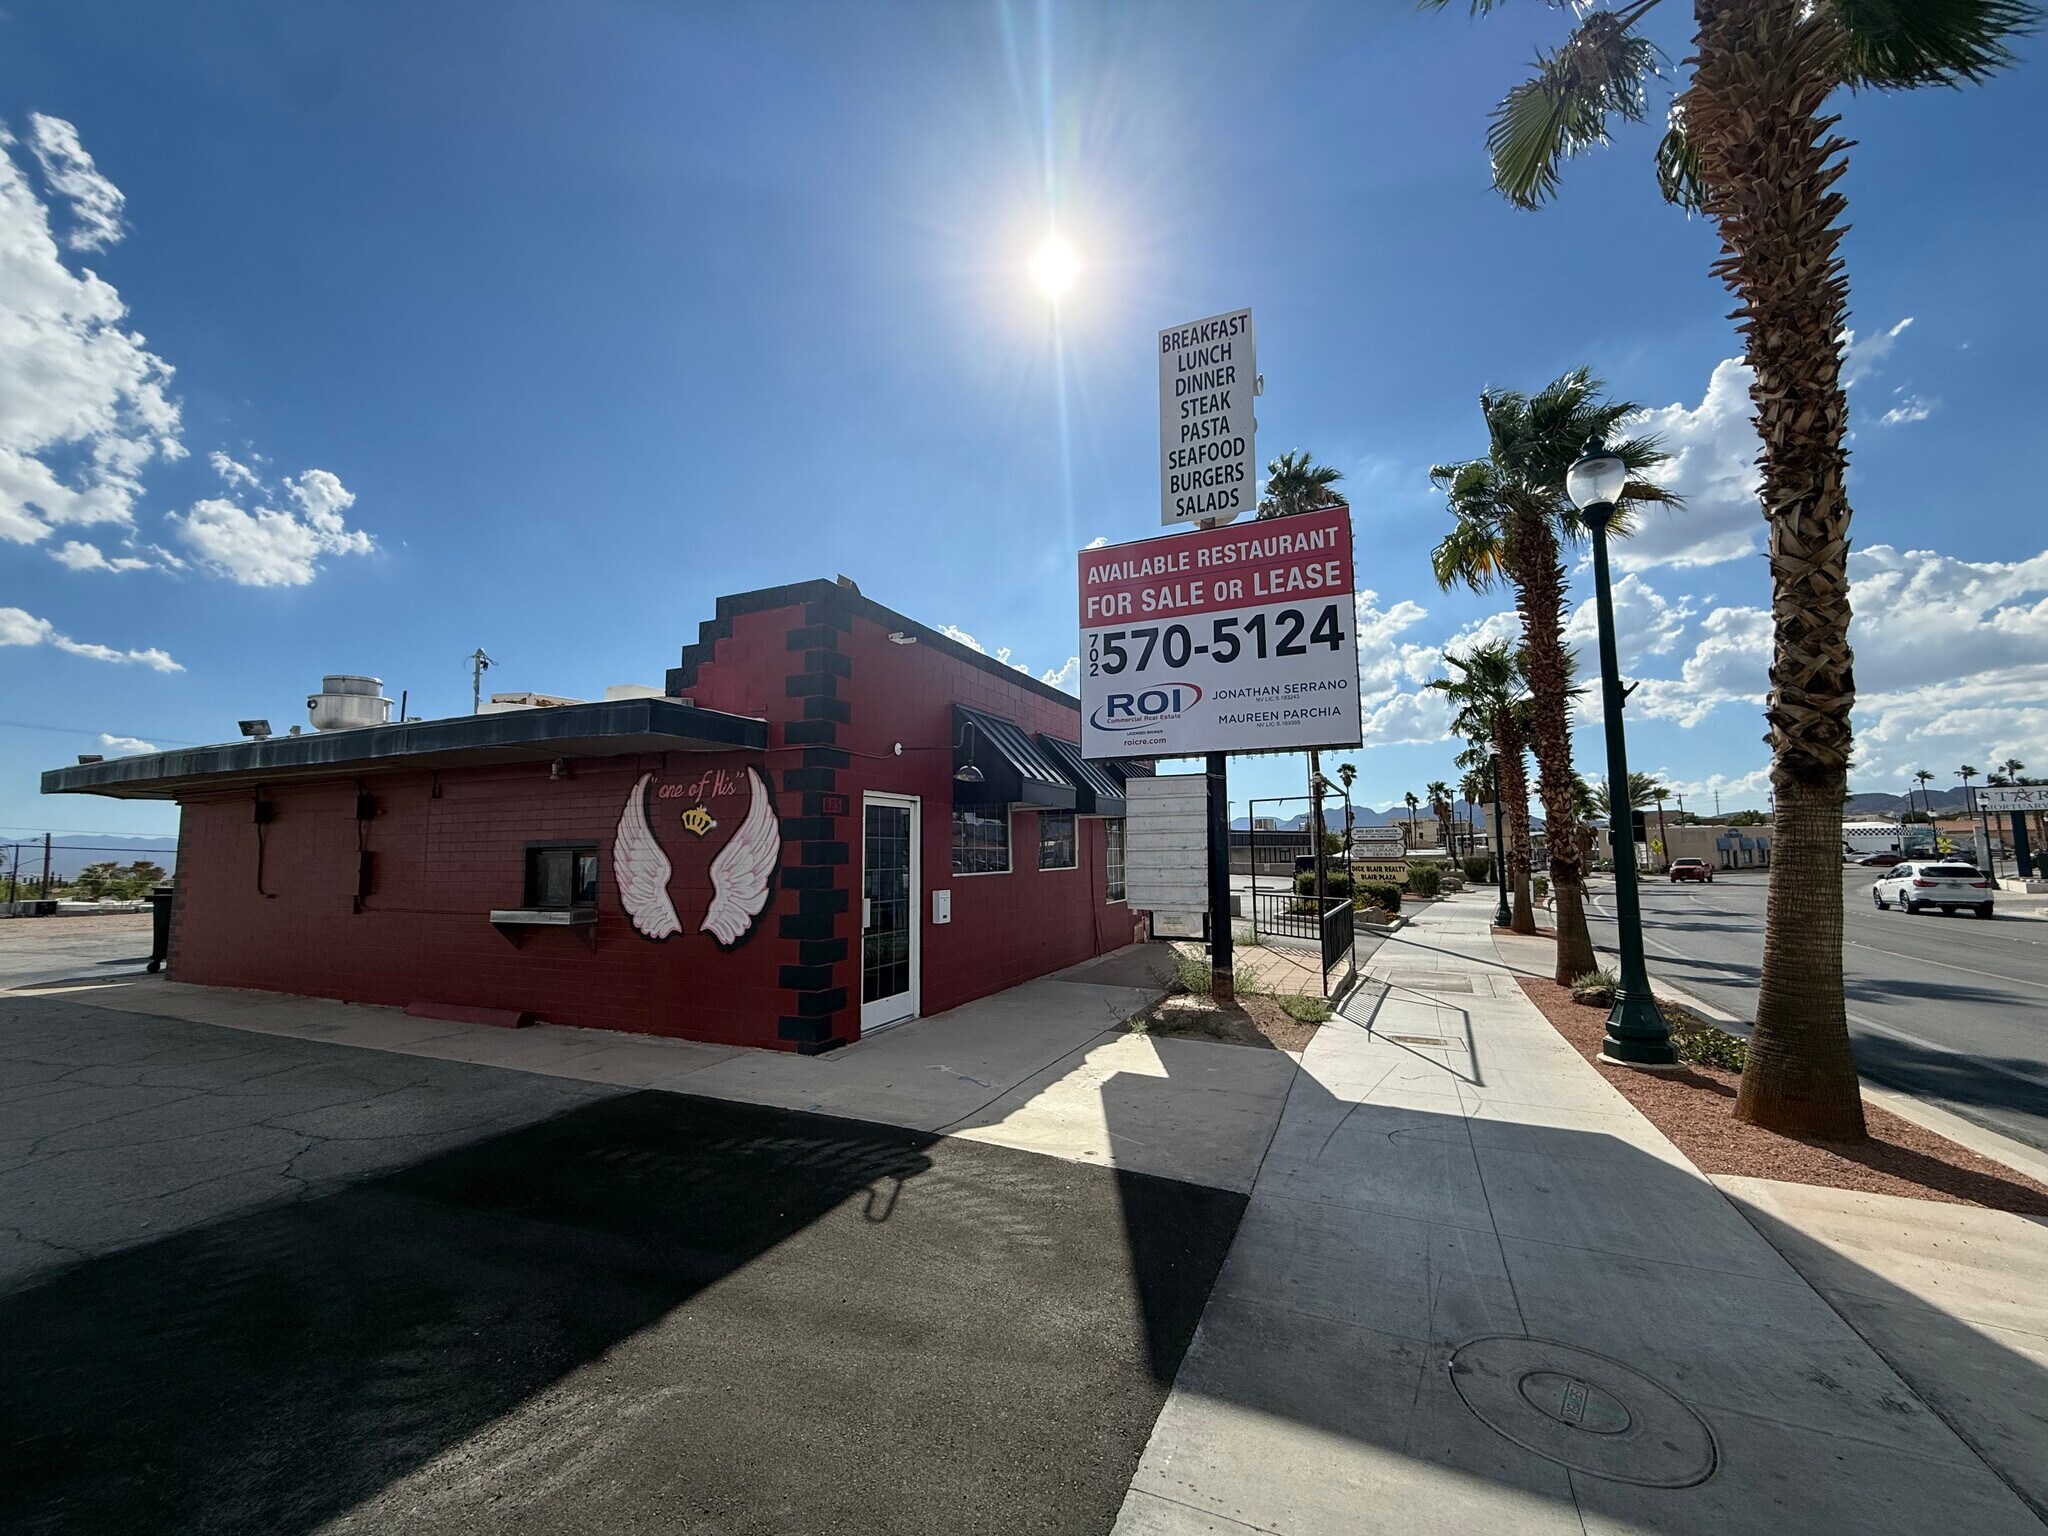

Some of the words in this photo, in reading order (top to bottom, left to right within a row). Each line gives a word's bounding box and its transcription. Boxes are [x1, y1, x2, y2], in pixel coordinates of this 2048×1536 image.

[1162, 314, 1248, 354] BREAKFAST
[1178, 341, 1232, 373] LUNCH
[1175, 365, 1236, 397] DINNER
[1180, 390, 1231, 420] STEAK
[1180, 415, 1231, 444] PASTA
[1168, 436, 1246, 470] SEAFOOD
[1170, 461, 1245, 494] BURGERS
[1176, 487, 1240, 517] SALADS
[1087, 551, 1190, 585] AVAILABLE
[1197, 526, 1339, 568] RESTAURANT
[1087, 591, 1132, 619] FOR
[1141, 581, 1204, 612] SALE
[1213, 579, 1243, 602] OR
[1253, 560, 1342, 596] LEASE
[1101, 604, 1345, 675] 570-5124
[1107, 689, 1181, 718] ROI
[1212, 685, 1280, 700] JONATHAN
[1284, 679, 1348, 694] SERRANO
[1107, 716, 1142, 724] Commercial
[1218, 711, 1279, 725] MAUREEN
[1283, 706, 1342, 720] PARCHIA
[1124, 737, 1167, 746] roicre.com
[688, 769, 714, 804] of
